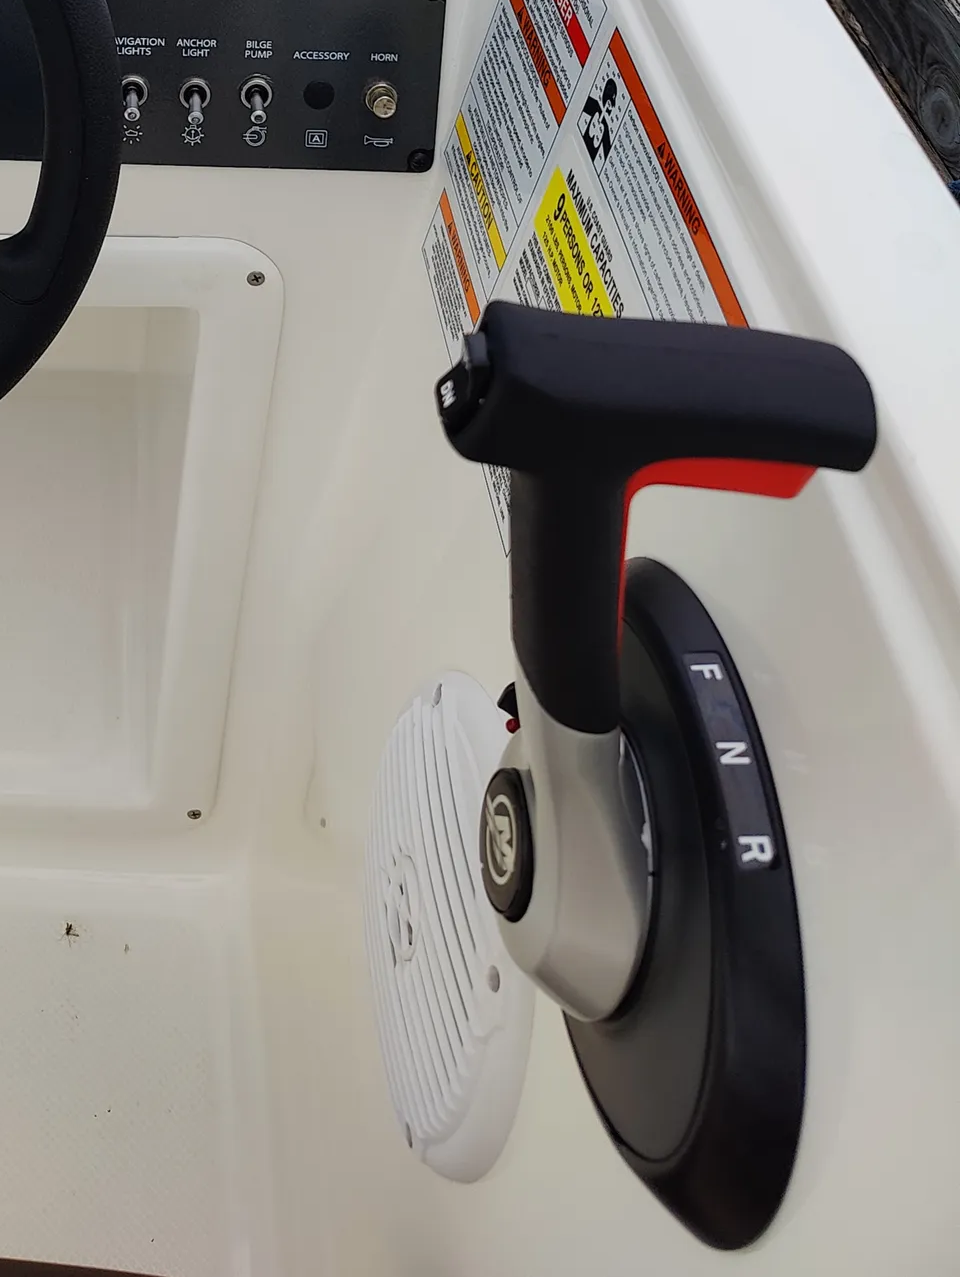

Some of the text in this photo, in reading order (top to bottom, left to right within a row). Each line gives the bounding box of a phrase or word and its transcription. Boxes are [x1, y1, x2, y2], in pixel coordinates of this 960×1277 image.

[115, 37, 166, 47] VIGATION
[116, 46, 152, 56] LIGHTS
[176, 39, 217, 48] ANCHOR
[182, 48, 210, 57] LIGHT
[244, 49, 273, 59] PUMP
[245, 40, 273, 49] BILGE
[521, 16, 551, 87] WARNING
[293, 51, 350, 61] ACCESSORY
[370, 52, 399, 62] HORN
[469, 162, 493, 230] CAUTION
[554, 192, 566, 222] 9
[662, 154, 701, 236] WARNING
[559, 211, 586, 277] PERSONS
[565, 168, 625, 319] MAXIMUM CAPACITIES
[591, 209, 603, 238] COAST
[600, 233, 613, 264] GUARD
[451, 229, 470, 294] WARNING
[582, 272, 593, 300] OR
[690, 663, 723, 681] F
[715, 742, 751, 764] N
[738, 835, 774, 863] R
